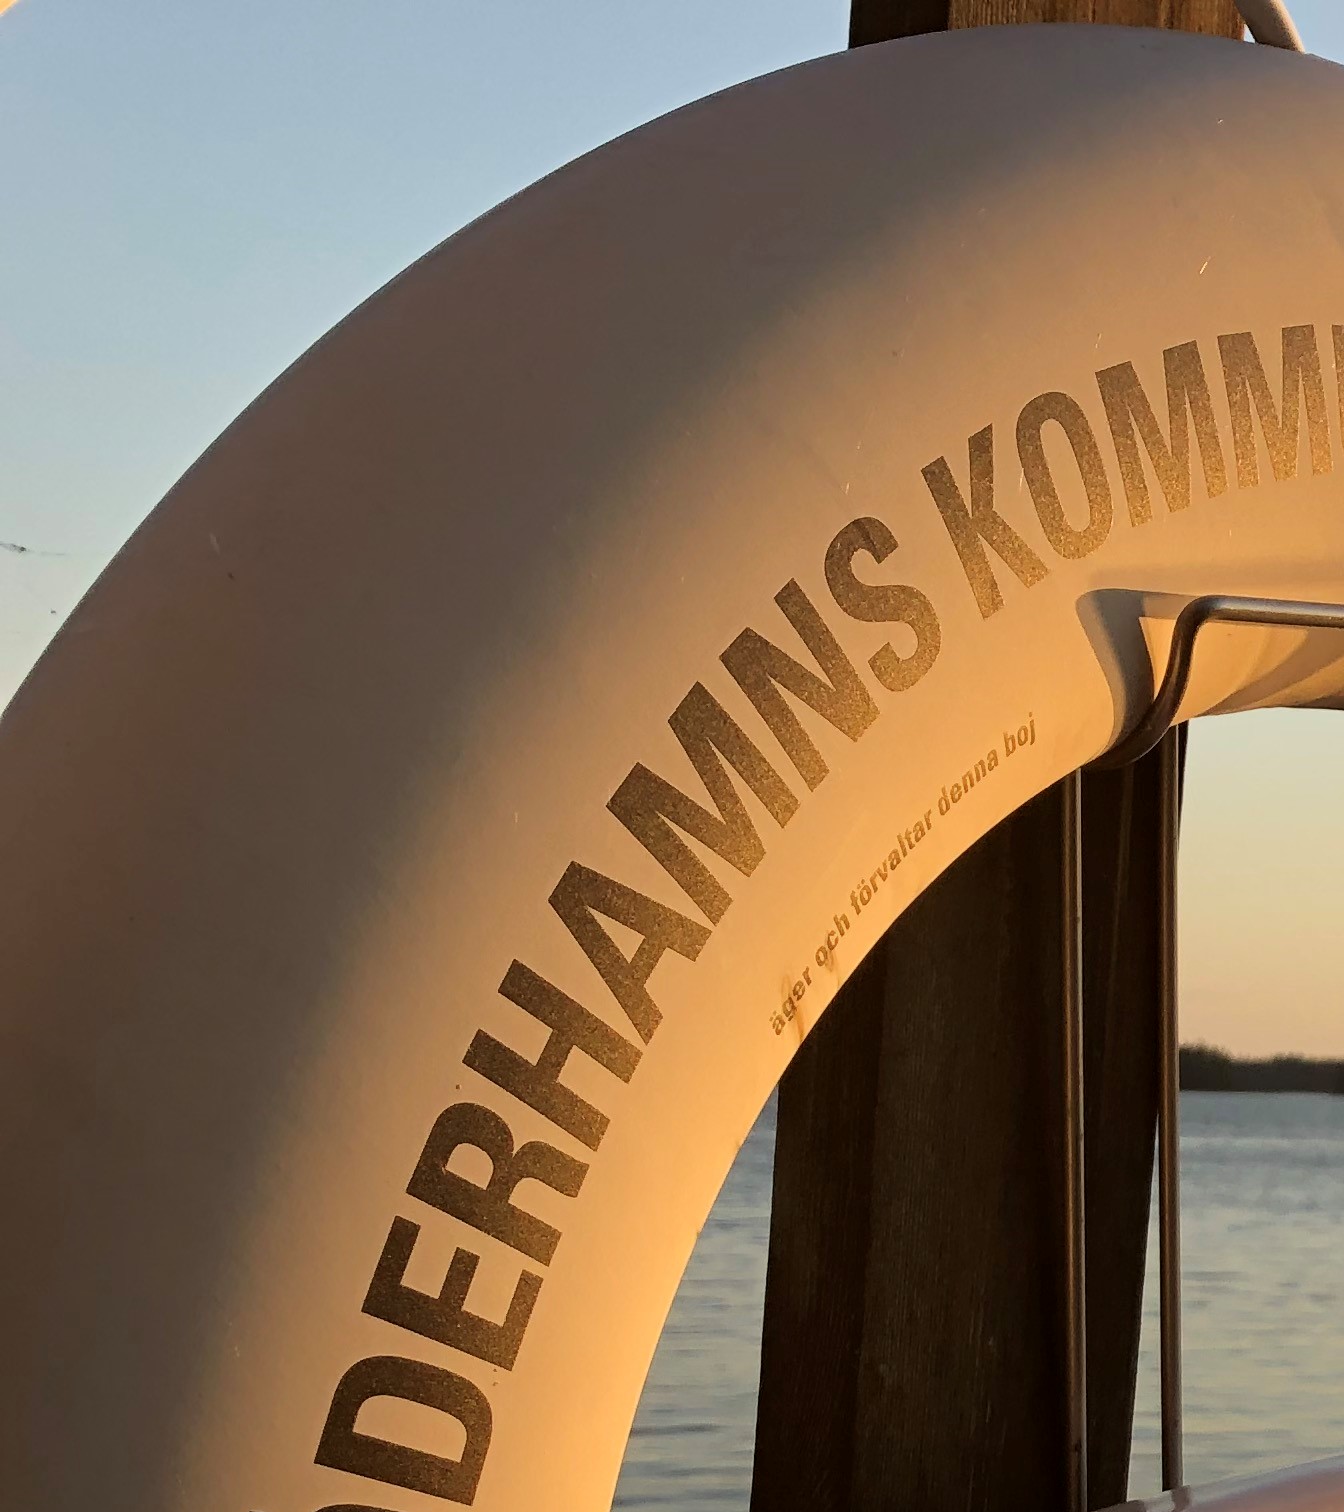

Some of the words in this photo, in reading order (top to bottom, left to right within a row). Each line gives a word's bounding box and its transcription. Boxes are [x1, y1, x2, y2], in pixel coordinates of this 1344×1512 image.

[768, 967, 812, 1035] äger
[814, 912, 851, 968] och
[849, 808, 933, 916] förvaltar
[937, 748, 999, 817] denna
[1002, 711, 1036, 758] boj
